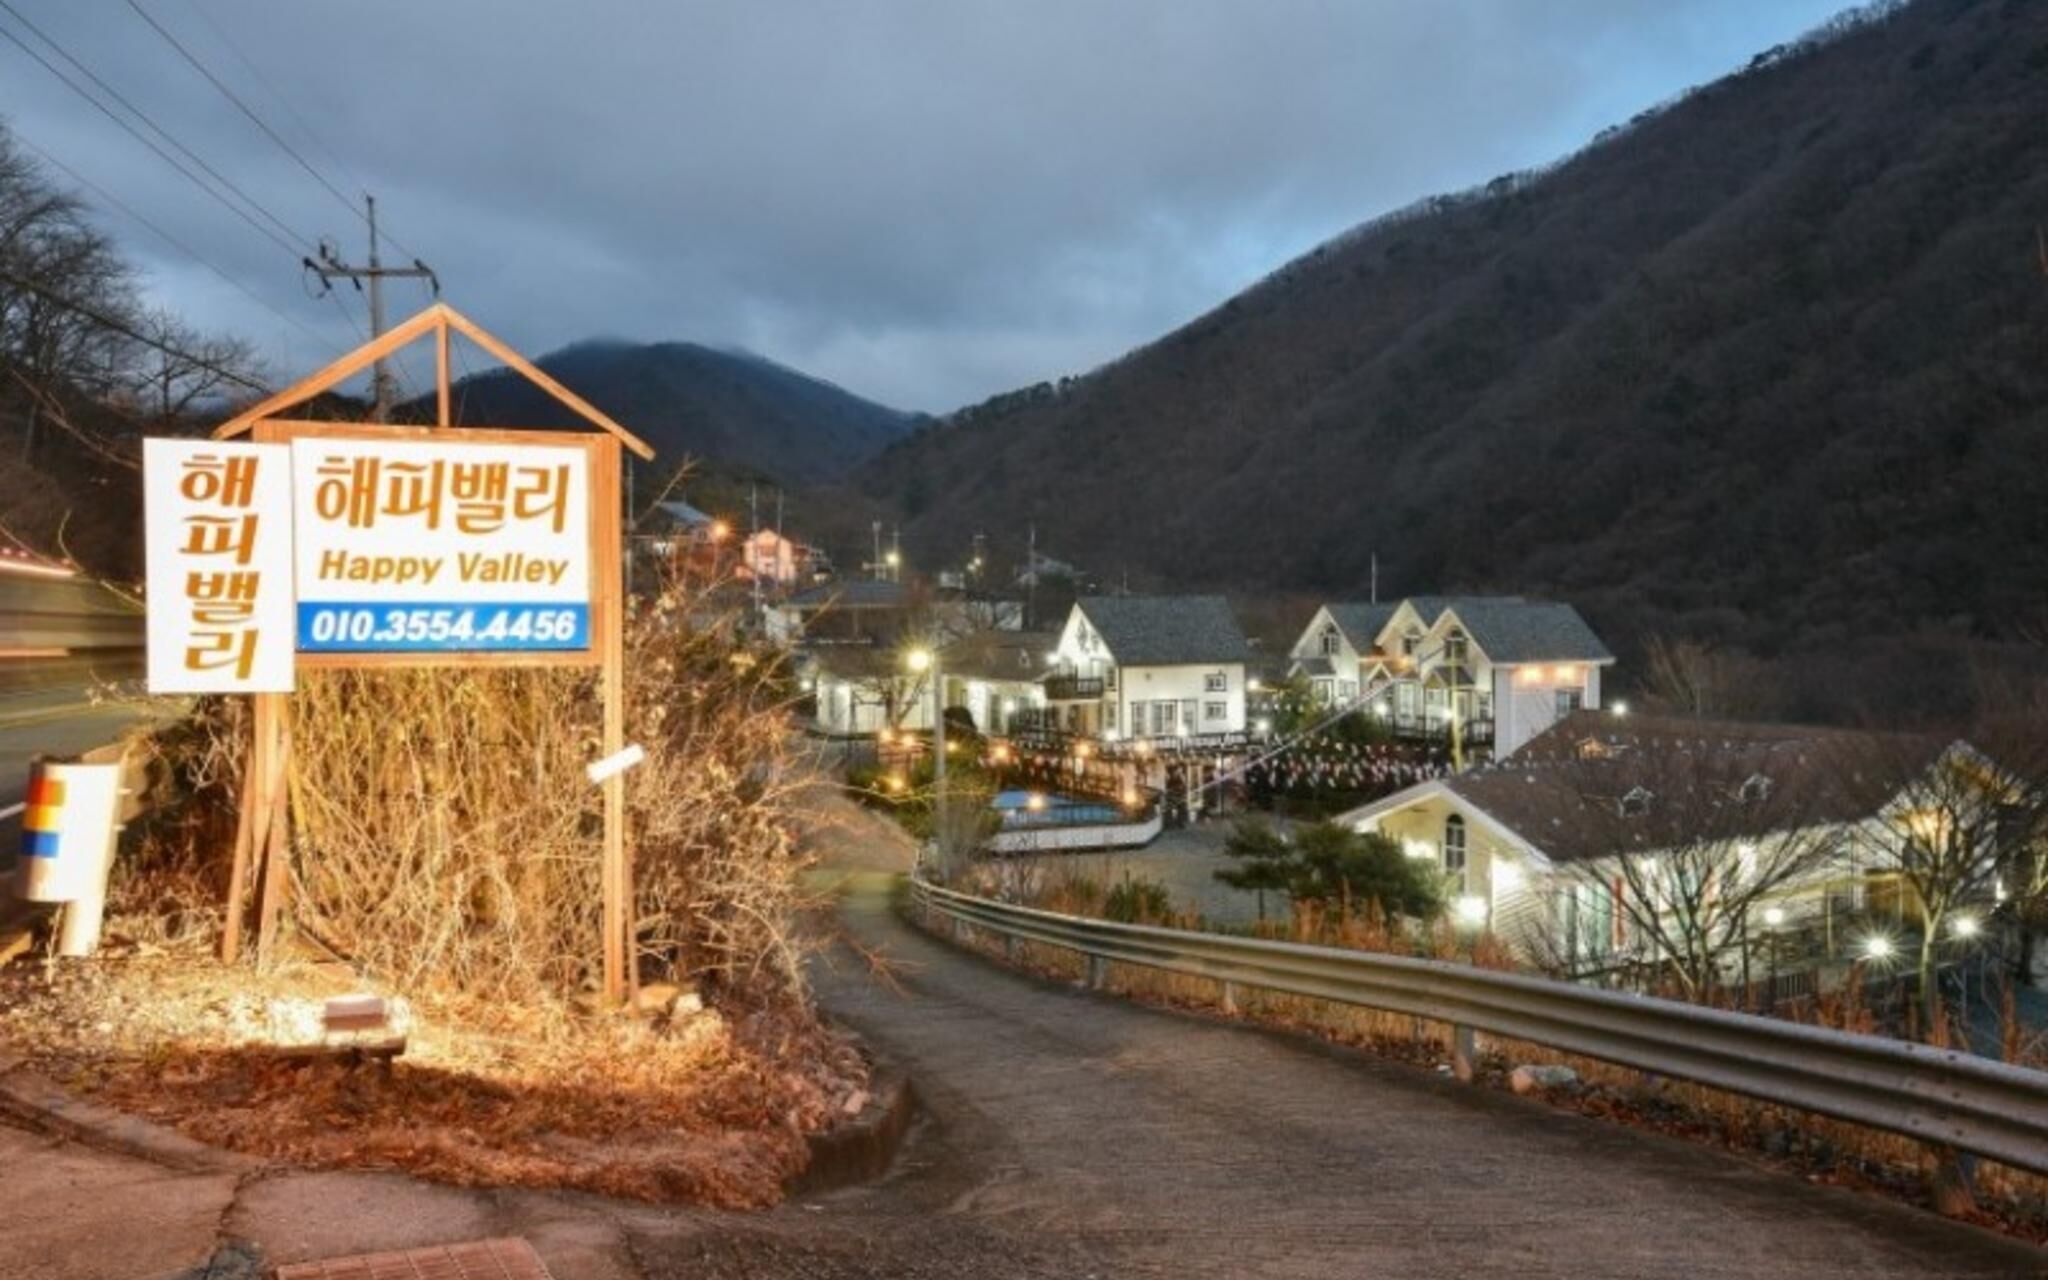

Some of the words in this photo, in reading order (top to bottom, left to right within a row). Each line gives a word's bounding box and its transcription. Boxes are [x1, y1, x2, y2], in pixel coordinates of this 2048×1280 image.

[315, 456, 570, 534] 해피밸리
[179, 454, 259, 680] 해피밸리
[319, 550, 442, 584] Happy
[457, 552, 569, 586] Valley
[312, 610, 576, 643] 010.3554.4456
